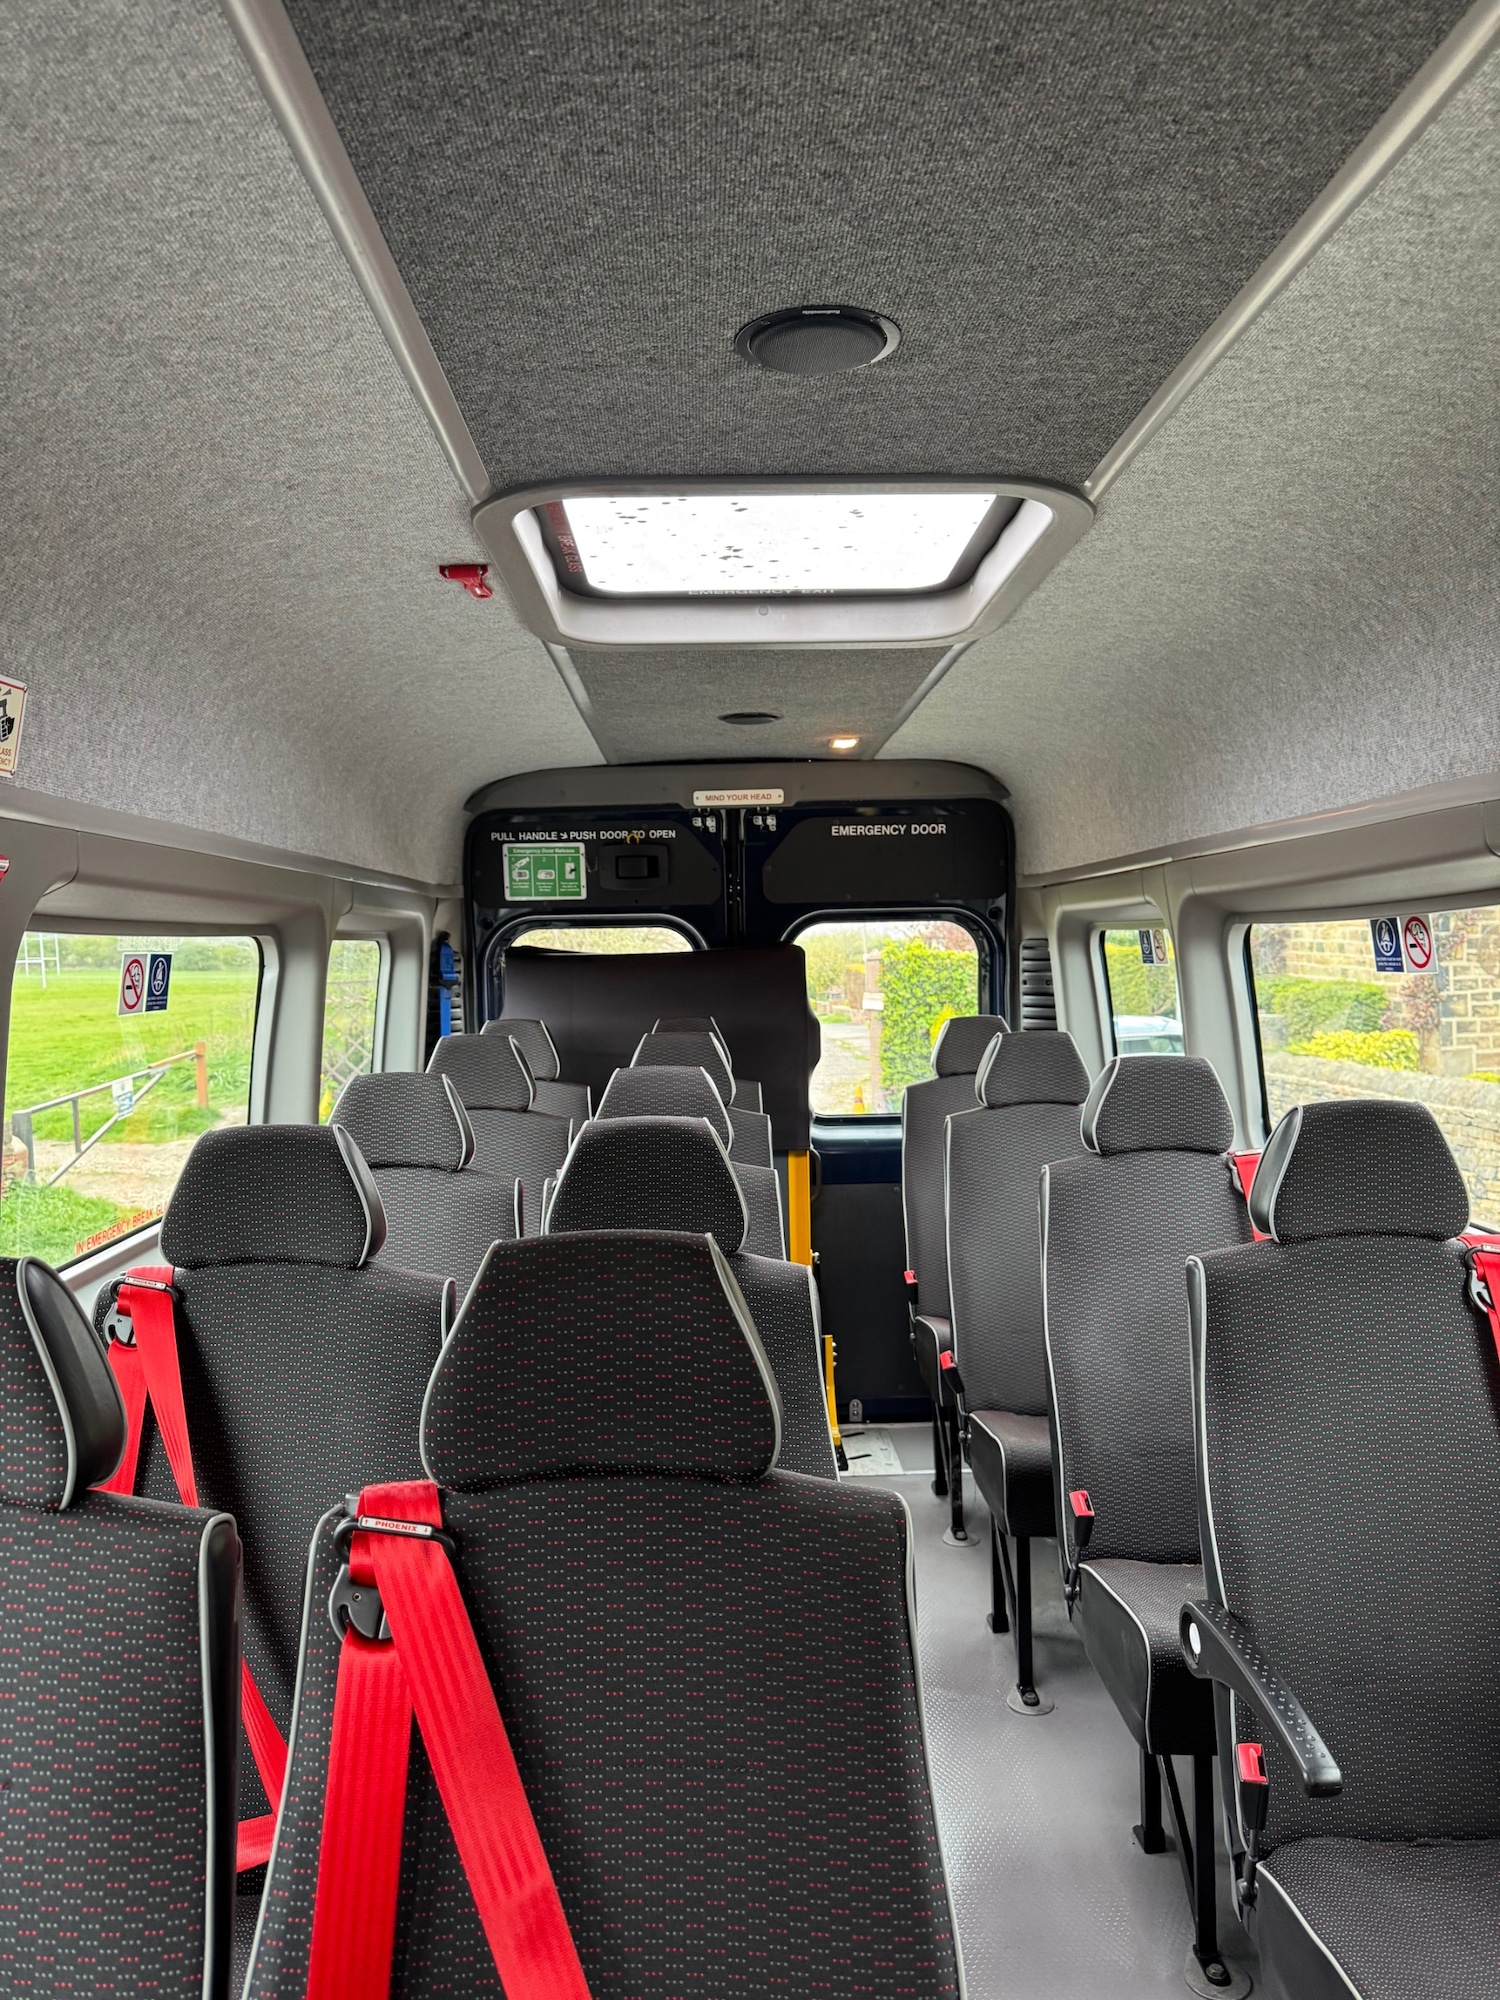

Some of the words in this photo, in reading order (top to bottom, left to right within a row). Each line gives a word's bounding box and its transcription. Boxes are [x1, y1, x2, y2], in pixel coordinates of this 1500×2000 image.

[490, 832, 515, 841] PULL
[518, 831, 558, 841] HANDLE
[569, 831, 597, 840] PUSH
[600, 830, 629, 840] DOOR
[648, 829, 676, 839] OPEN
[831, 824, 907, 836] EMERGENCY
[910, 823, 947, 835] DOOR
[76, 1241, 84, 1256] IN
[86, 1219, 131, 1251] EMERGENCY
[132, 1209, 153, 1228] BREAK
[374, 1520, 418, 1532] PHOENIX
